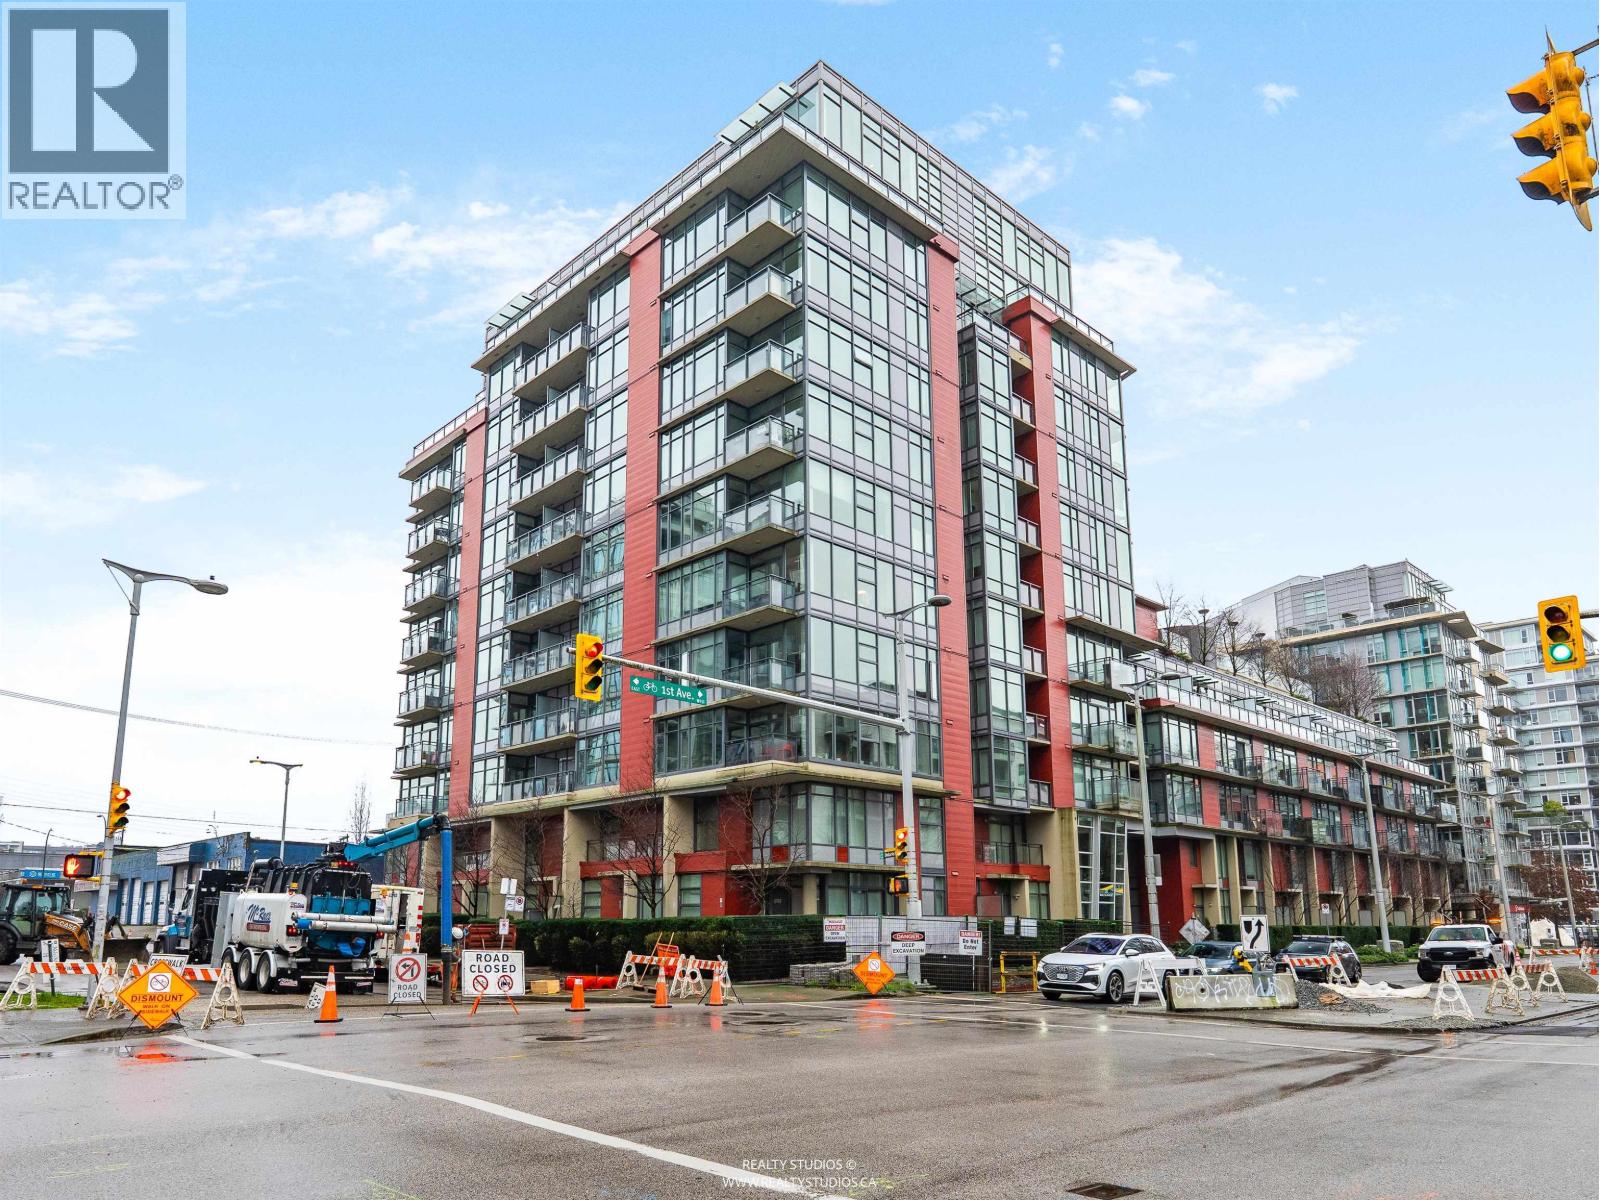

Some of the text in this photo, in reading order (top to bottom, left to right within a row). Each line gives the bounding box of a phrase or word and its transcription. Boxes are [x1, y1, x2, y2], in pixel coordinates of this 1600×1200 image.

[661, 686, 694, 700] 1st Ave.
[59, 920, 78, 932] CASE
[476, 953, 509, 963] ROAD
[469, 964, 517, 974] CLOSED
[131, 994, 183, 1003] DISMOUNT
